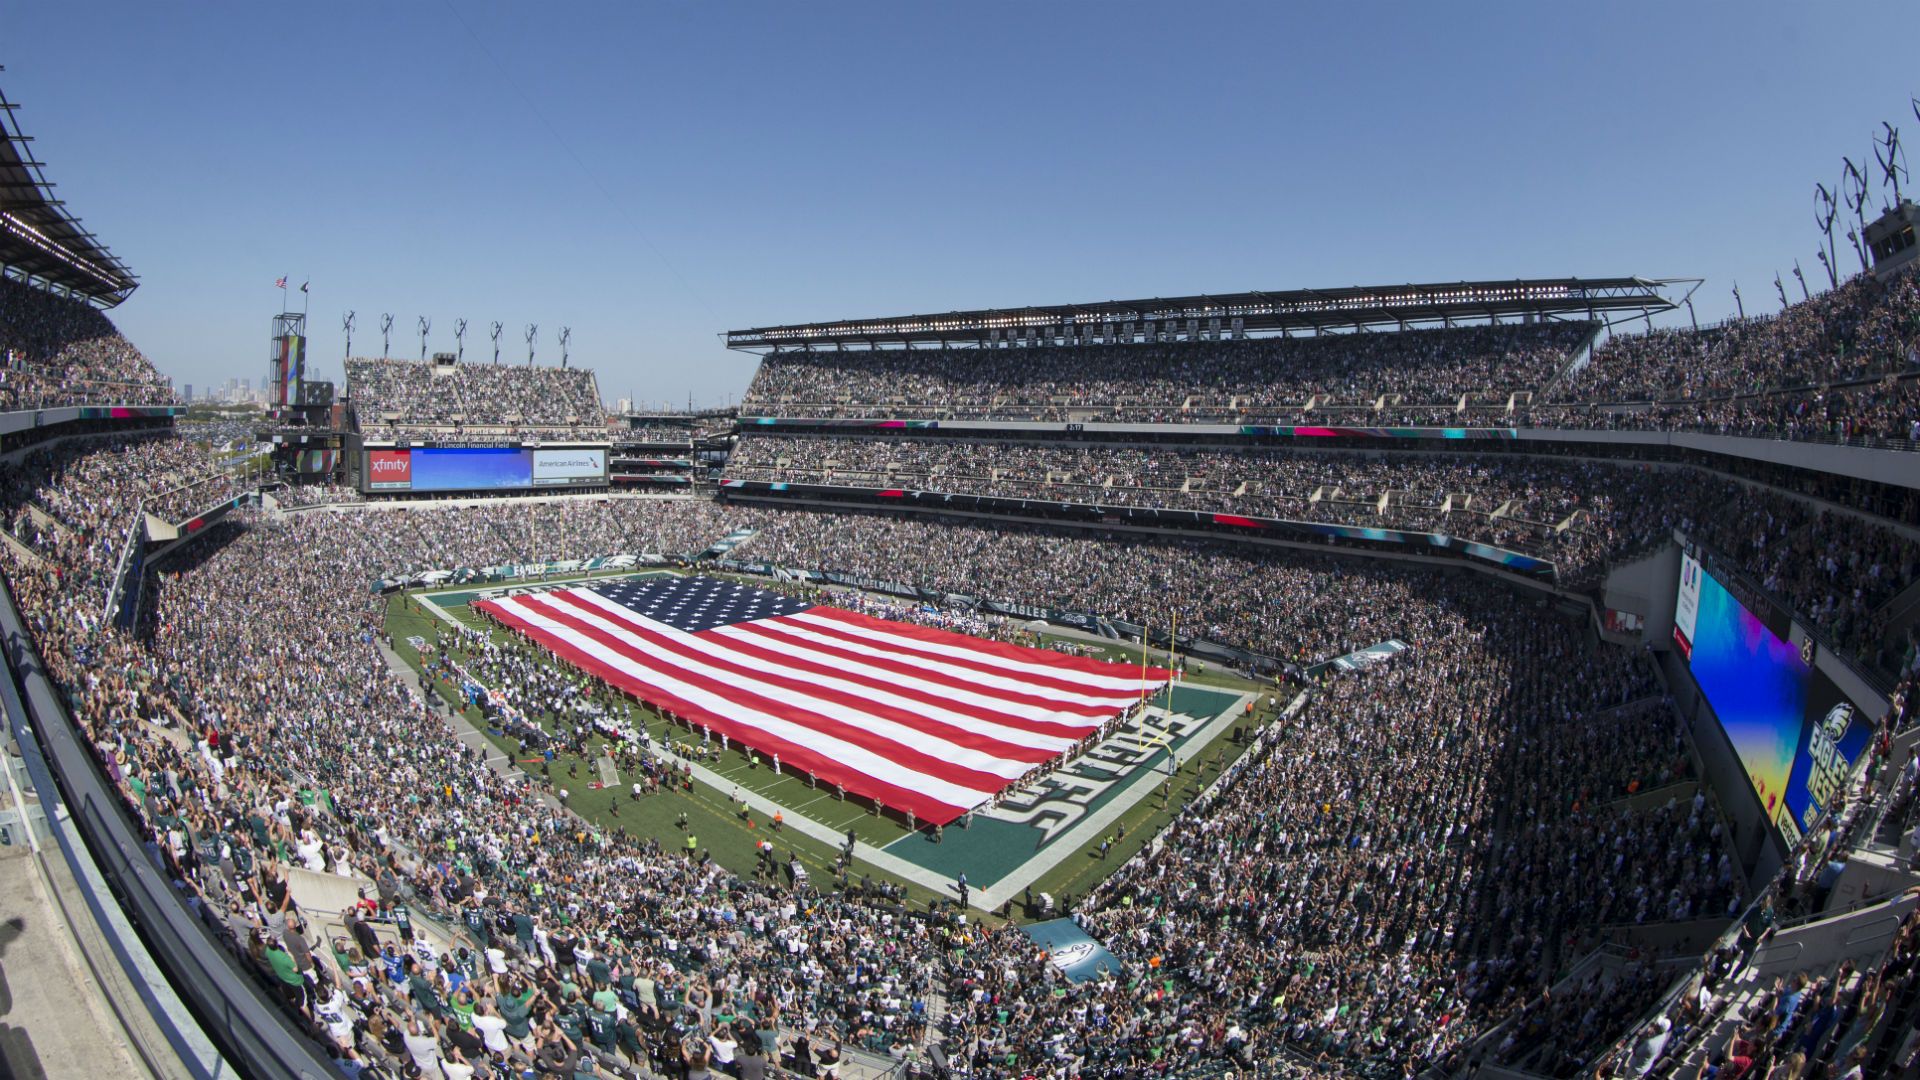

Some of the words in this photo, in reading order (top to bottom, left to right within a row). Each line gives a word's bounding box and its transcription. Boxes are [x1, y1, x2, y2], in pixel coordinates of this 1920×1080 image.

[372, 458, 409, 473] xfinity
[839, 573, 901, 593] PHILADELPHIA
[1002, 602, 1048, 619] EAGLES
